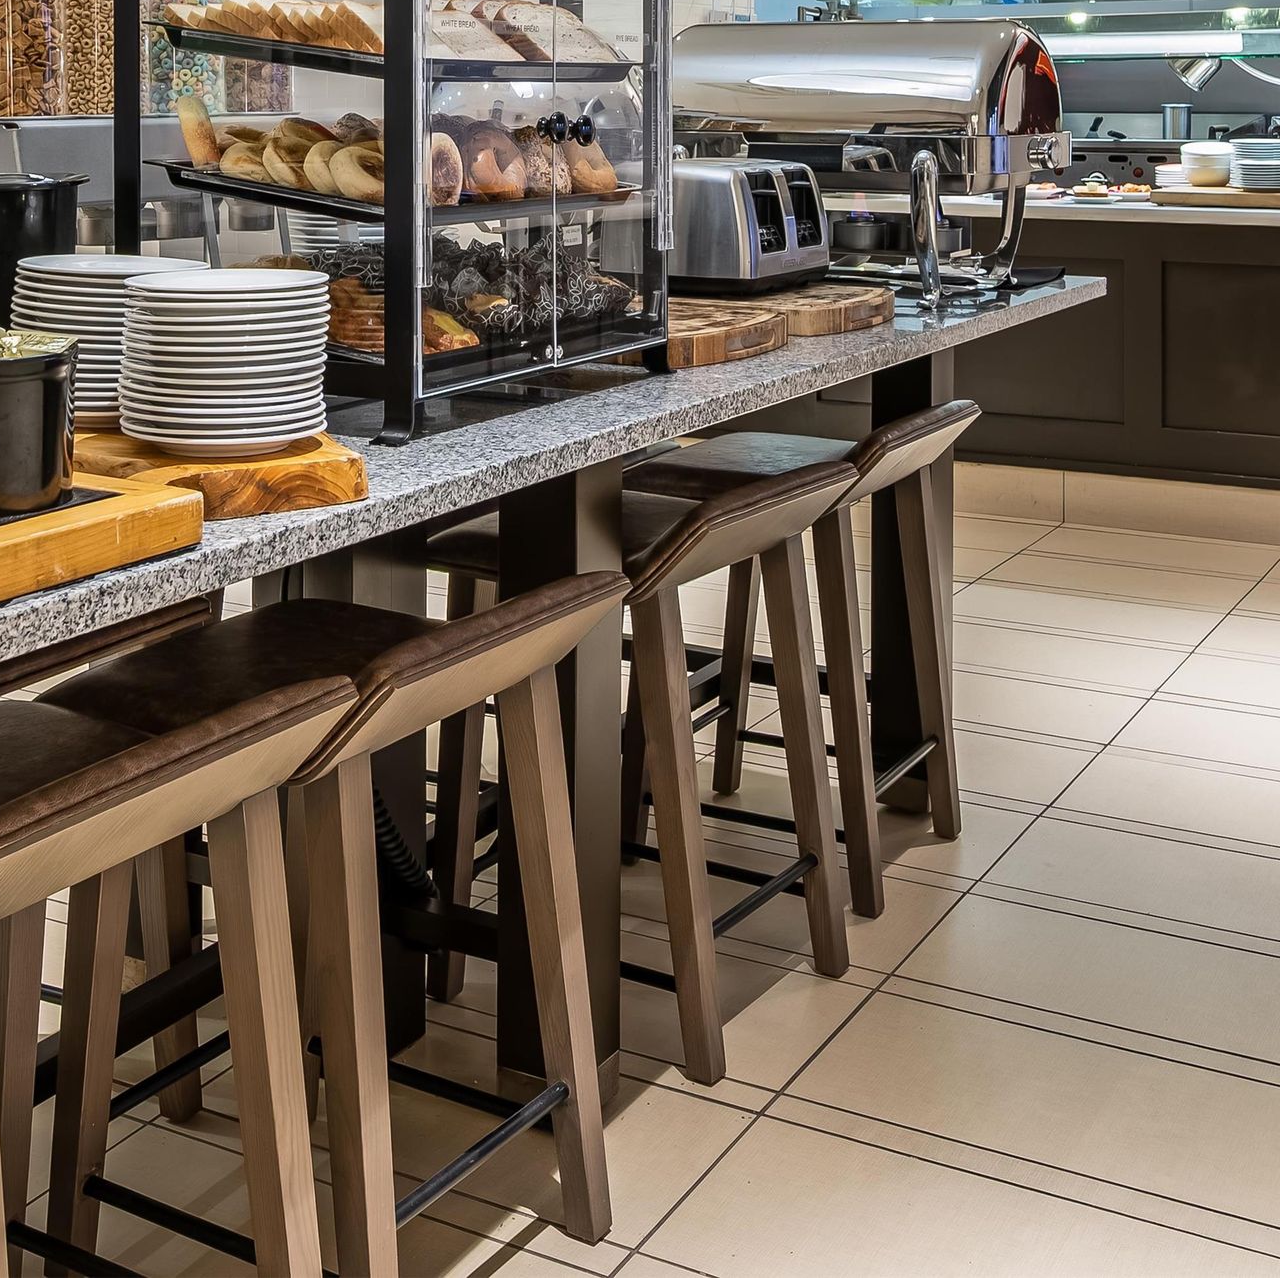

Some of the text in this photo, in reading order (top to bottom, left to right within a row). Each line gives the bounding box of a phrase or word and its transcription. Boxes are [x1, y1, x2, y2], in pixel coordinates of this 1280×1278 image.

[441, 19, 476, 28] WHITE BREAD
[524, 25, 540, 33] BREAD
